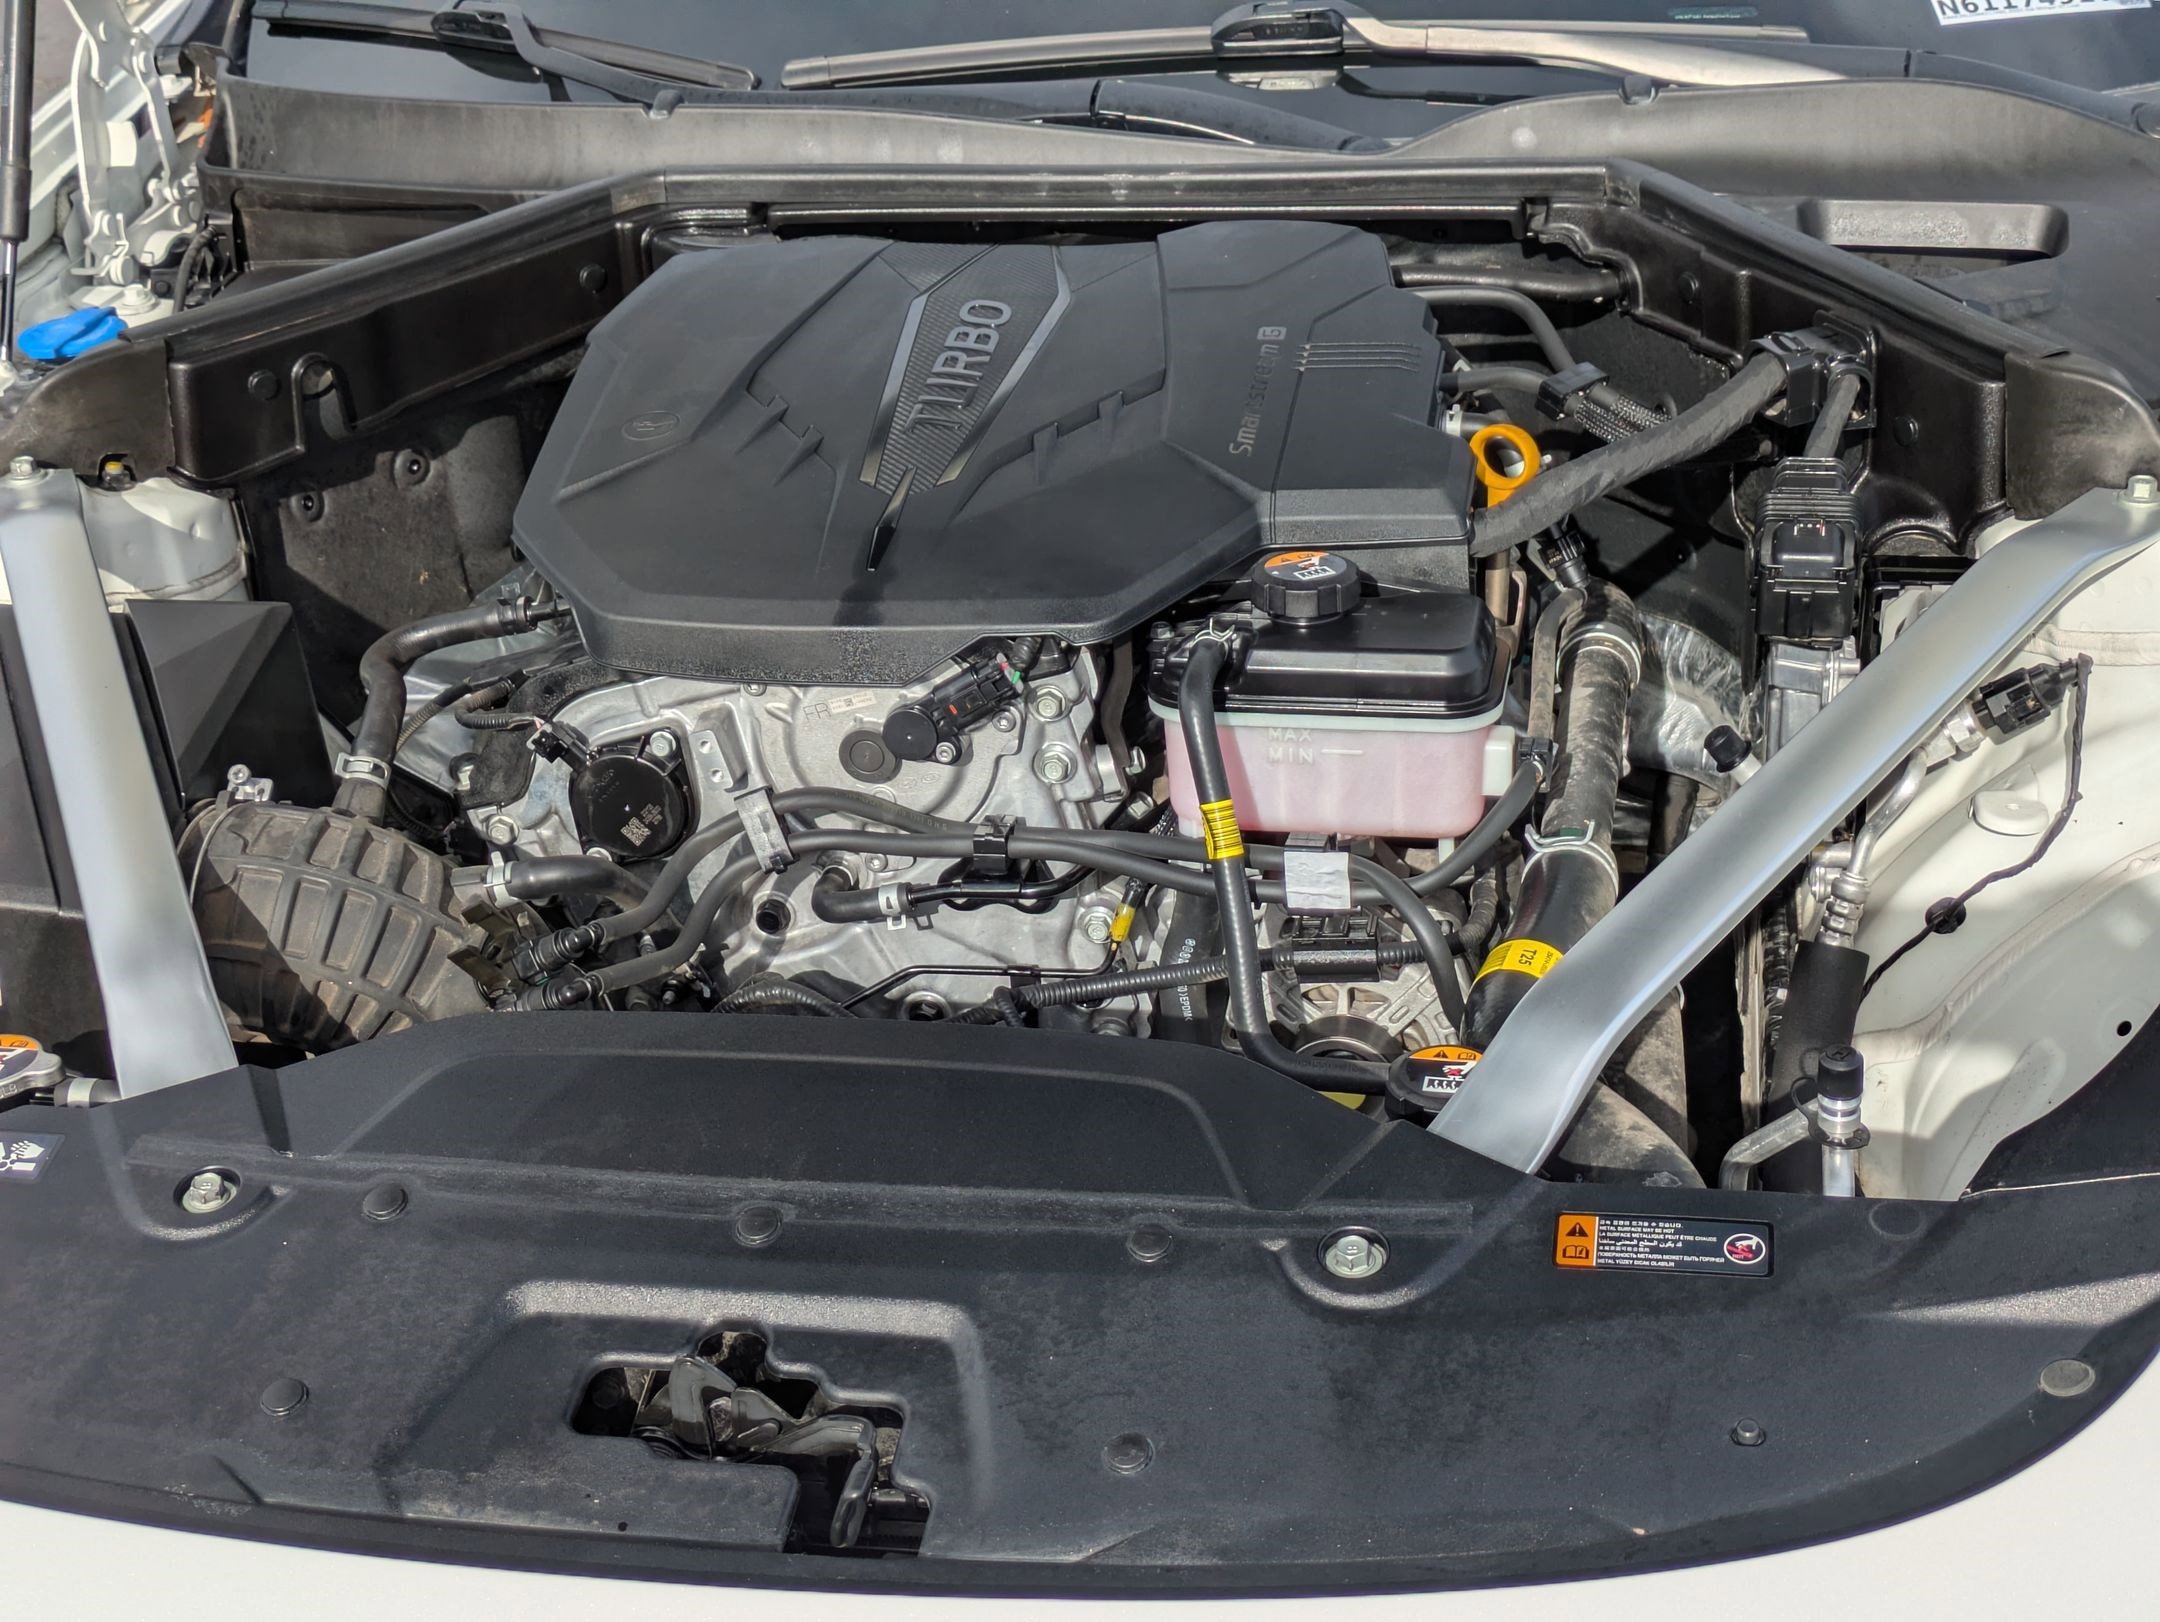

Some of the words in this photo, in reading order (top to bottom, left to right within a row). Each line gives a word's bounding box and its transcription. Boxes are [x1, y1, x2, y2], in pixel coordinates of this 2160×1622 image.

[904, 299, 1012, 433] TURBO
[1229, 343, 1280, 457] Smartstream
[803, 703, 831, 720] FR
[1268, 727, 1312, 741] MAX
[1269, 747, 1313, 763] MIN
[1518, 948, 1537, 966] T25
